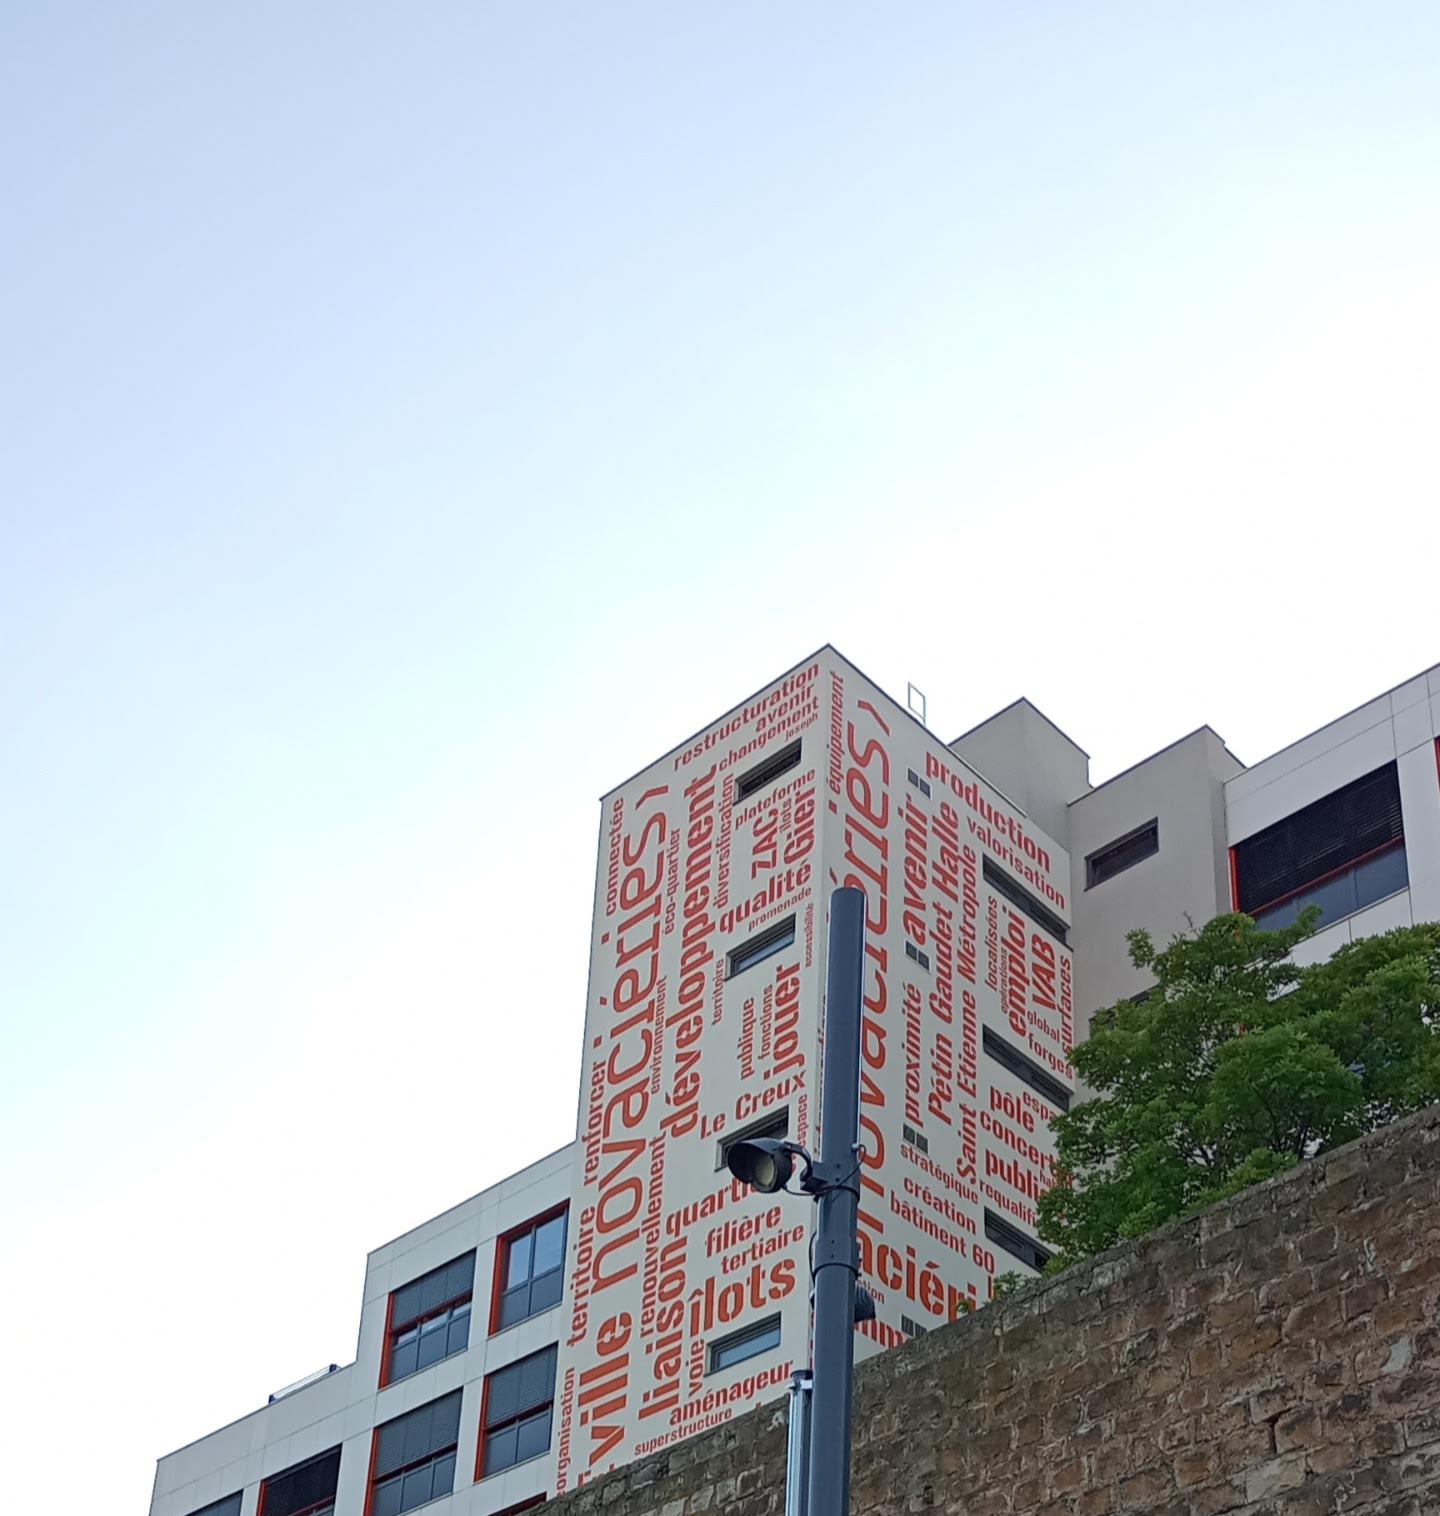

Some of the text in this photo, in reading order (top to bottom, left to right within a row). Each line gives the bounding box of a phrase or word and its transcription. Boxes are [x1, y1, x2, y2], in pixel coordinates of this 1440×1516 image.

[674, 664, 819, 771] restructuration
[718, 699, 819, 771] changement
[755, 685, 815, 732] avenir
[735, 769, 815, 830] plateforme
[784, 787, 815, 865] Gier
[926, 751, 1050, 873] production
[606, 798, 624, 917] connectée
[713, 773, 734, 909] diversification
[751, 807, 779, 880] ZAC
[898, 793, 928, 946] avenir
[967, 816, 1065, 911] valorisation
[719, 858, 811, 933] qualité
[748, 888, 811, 932] promenade
[659, 764, 718, 1138] développement
[928, 801, 959, 1126] Pétin Gaudet Halle
[1001, 905, 1030, 1037] emploi
[650, 975, 667, 1095] environnement
[737, 997, 755, 1080] publique
[758, 984, 773, 1060] fonctions
[764, 962, 804, 1080] jouer
[956, 845, 980, 1185] Saint Etienne Métropole
[1027, 1010, 1060, 1044] global
[1057, 955, 1073, 1056] surfaces
[902, 981, 924, 1128] proximité
[1028, 1033, 1073, 1080] forges
[582, 1059, 606, 1186] renforcer
[700, 1070, 806, 1140] Le Creux
[980, 1110, 1057, 1173] concert
[990, 1085, 1034, 1133] pôle
[1023, 1091, 1057, 1121] espa
[900, 1145, 978, 1205] stratégique
[903, 1177, 976, 1235] création
[979, 1179, 1037, 1227] requalifi
[640, 1131, 667, 1337] renouvellement
[705, 1206, 781, 1258] filière
[721, 1224, 804, 1275] tertiaire
[891, 1190, 994, 1274] bâtiment 60
[567, 1206, 596, 1347] territoire
[688, 1258, 795, 1337] îlots
[638, 1236, 688, 1420] liaison
[577, 1312, 632, 1466] ville
[669, 1360, 794, 1425] aménageur
[686, 1338, 705, 1397] voie
[634, 1408, 732, 1455] superstructure
